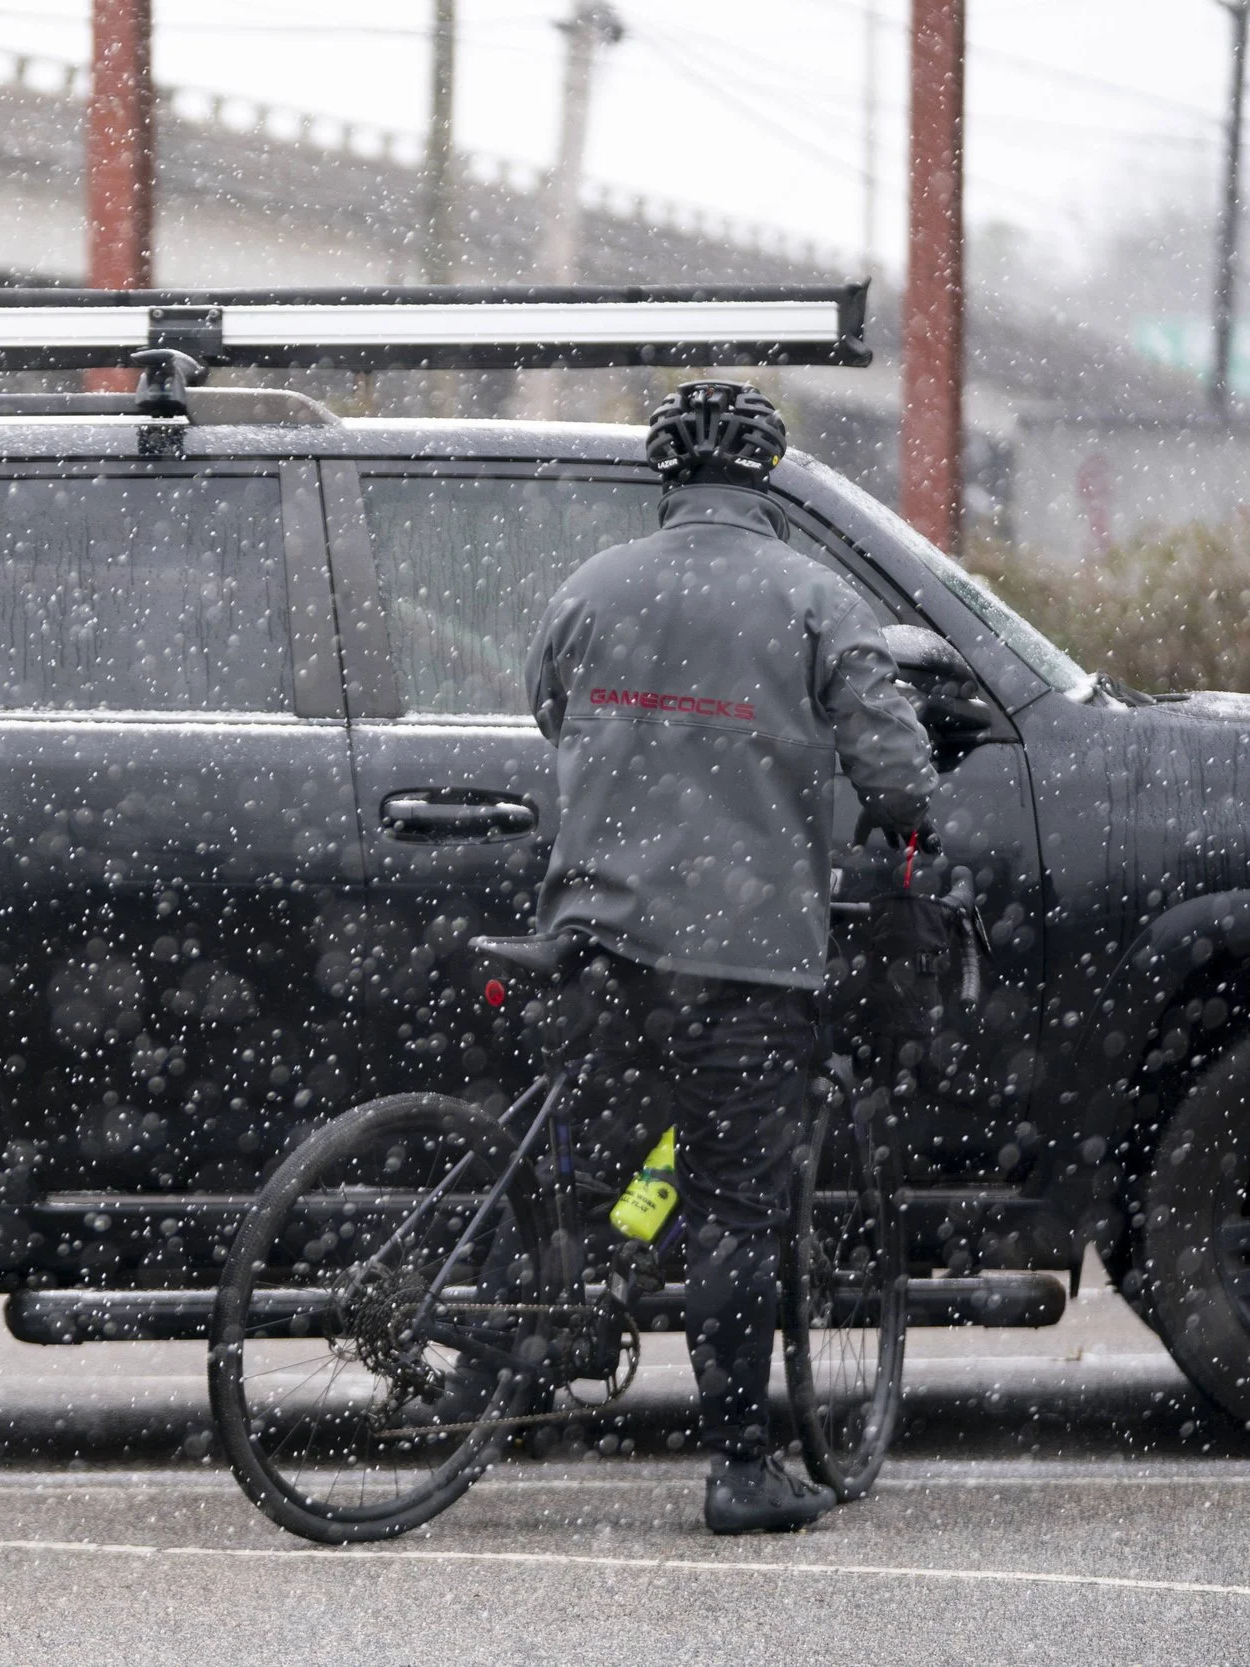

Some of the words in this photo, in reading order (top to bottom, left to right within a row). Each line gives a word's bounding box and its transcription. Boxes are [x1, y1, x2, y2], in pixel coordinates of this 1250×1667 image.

[657, 458, 678, 469] LAZER
[734, 457, 762, 469] LAZER
[590, 688, 756, 720] GAMECOCKS
